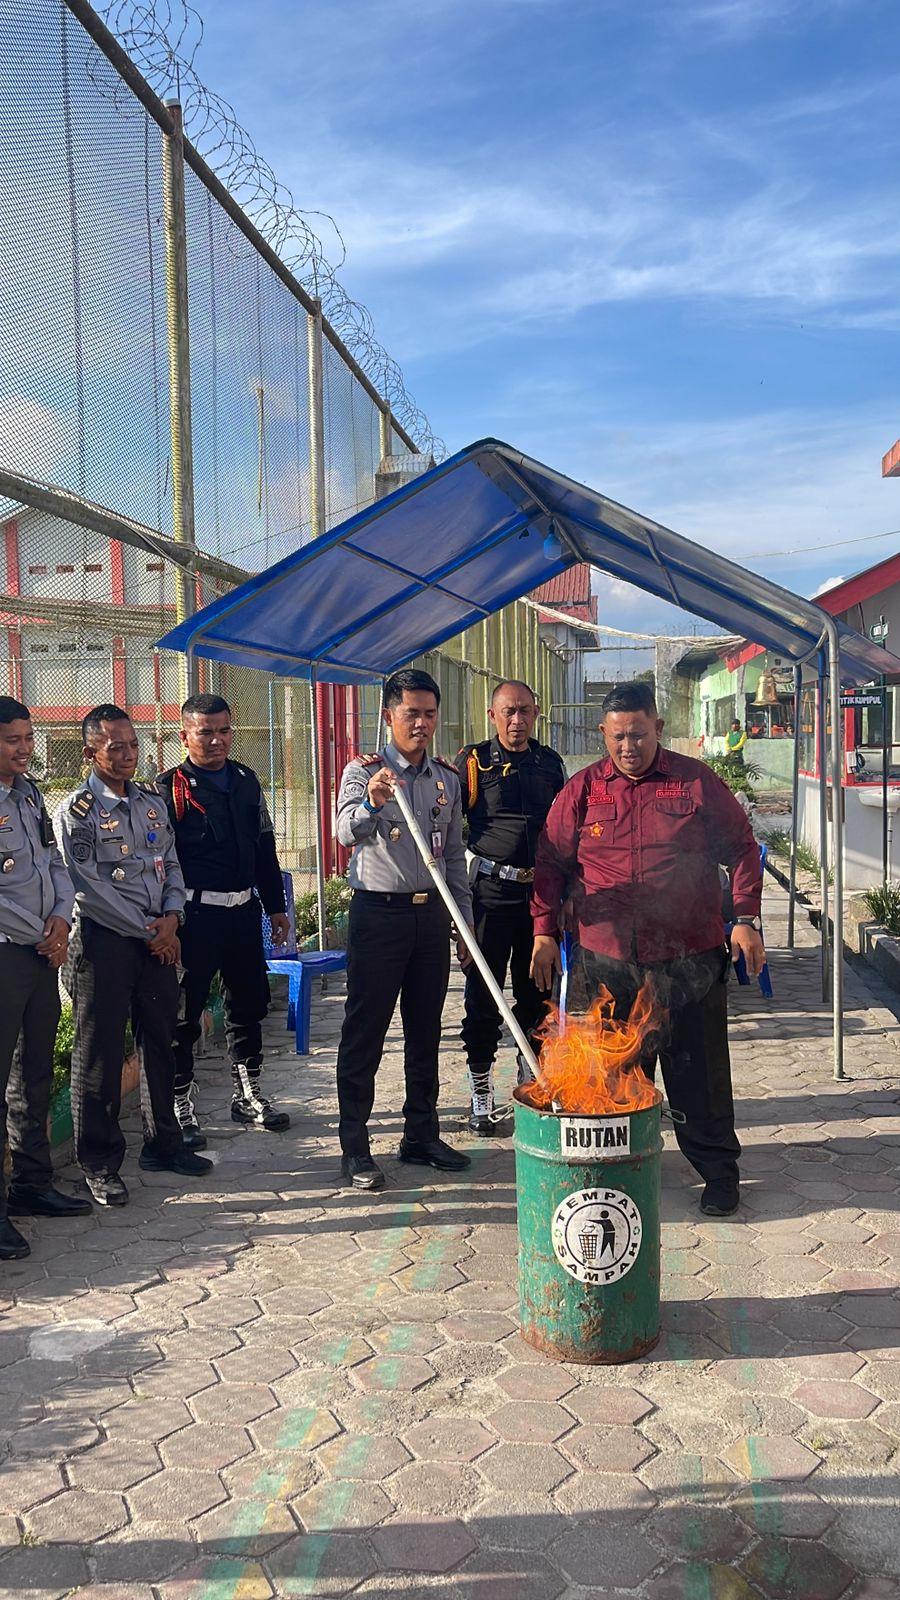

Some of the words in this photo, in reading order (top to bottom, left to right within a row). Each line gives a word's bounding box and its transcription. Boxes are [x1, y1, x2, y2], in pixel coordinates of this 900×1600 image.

[840, 697, 854, 705] ITIK
[855, 696, 881, 704] KUMPUL
[565, 1126, 627, 1148] RUTAN
[556, 1192, 638, 1223] TEMPAT
[557, 1242, 638, 1281] SAMPAH
